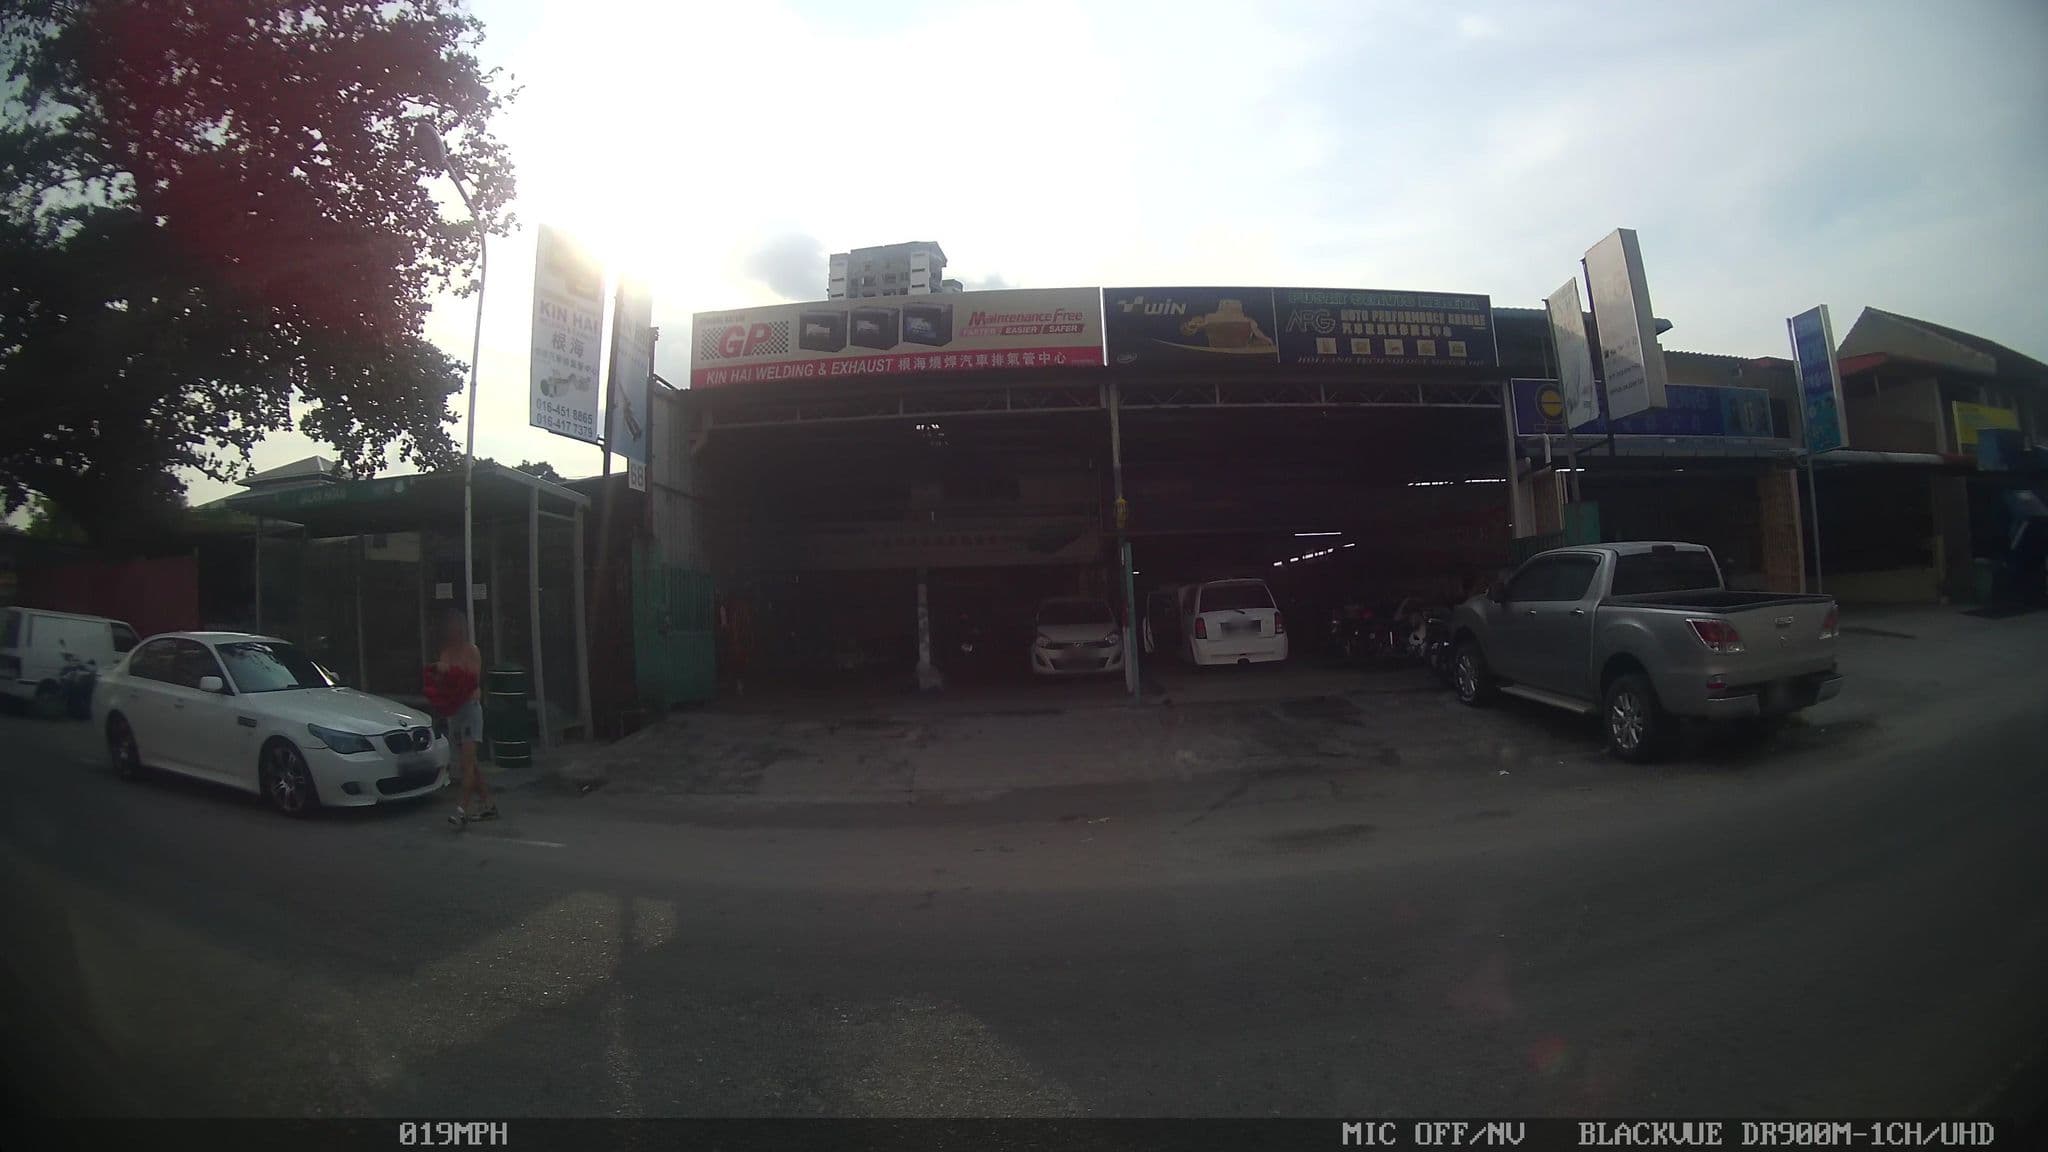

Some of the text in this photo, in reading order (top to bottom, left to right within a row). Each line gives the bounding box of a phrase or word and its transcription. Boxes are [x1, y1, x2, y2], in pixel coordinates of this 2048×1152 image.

[541, 300, 567, 322] KIN
[573, 312, 598, 334] HAI
[969, 308, 1083, 326] Maintenance Free
[1006, 326, 1037, 334] EASIER
[1049, 325, 1078, 333] SAFER
[718, 323, 772, 358] GP
[706, 370, 727, 384] KIN
[731, 369, 751, 383] HAI
[756, 364, 813, 379] WELDING
[818, 362, 827, 376] &
[831, 358, 893, 375] EXHAUST
[536, 398, 570, 417] 016-451
[536, 413, 571, 431] 016-417
